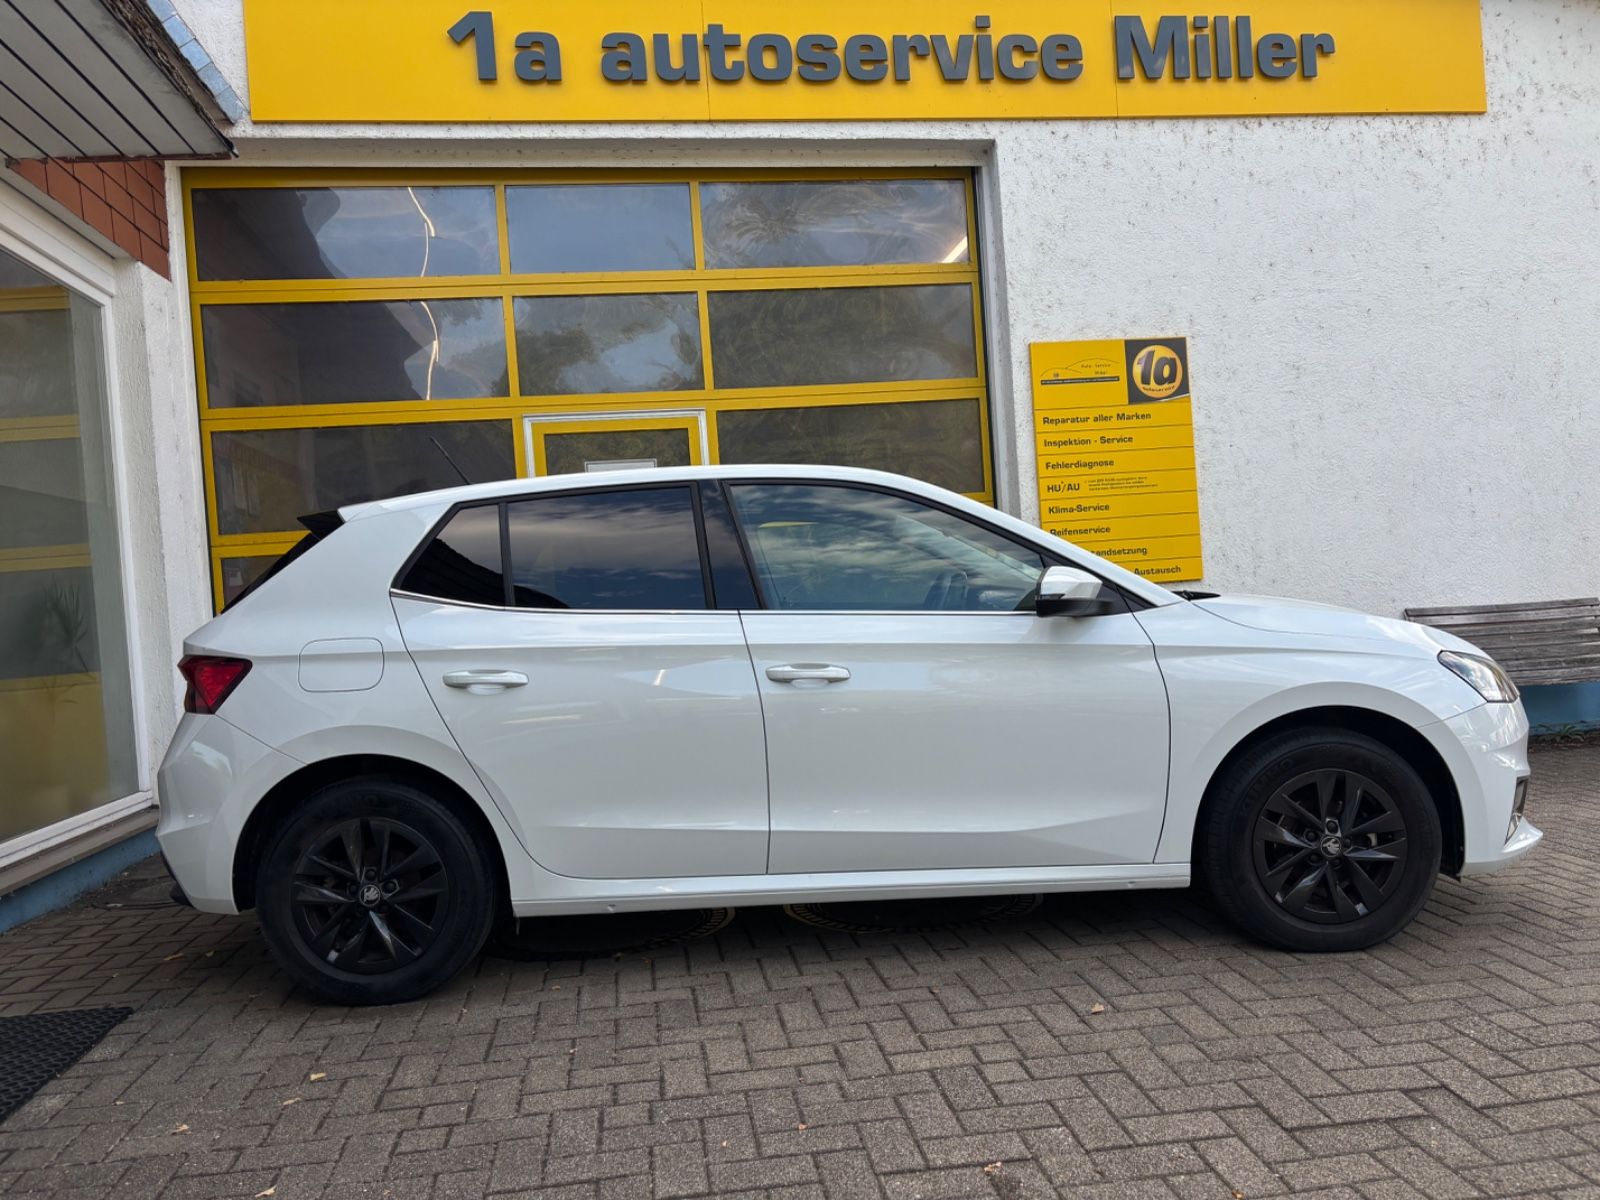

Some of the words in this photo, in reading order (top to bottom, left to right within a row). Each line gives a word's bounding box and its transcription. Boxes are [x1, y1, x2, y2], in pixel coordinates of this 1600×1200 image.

[446, 11, 562, 82] 1a
[601, 15, 1083, 83] autoservice
[1114, 15, 1335, 80] Miller
[1137, 350, 1177, 386] 1a
[1043, 416, 1090, 426] Reparatur
[1093, 414, 1113, 422] aller
[1116, 412, 1151, 421] Marken
[1044, 438, 1091, 448] Inspektion
[1100, 435, 1133, 444] Service
[1045, 460, 1114, 470] Fehlerdiagnose
[1048, 503, 1110, 514] Klima-Service
[1050, 526, 1111, 536] Reifenservice
[1091, 547, 1147, 556] andsetzung
[1134, 565, 1181, 575] Austausch
